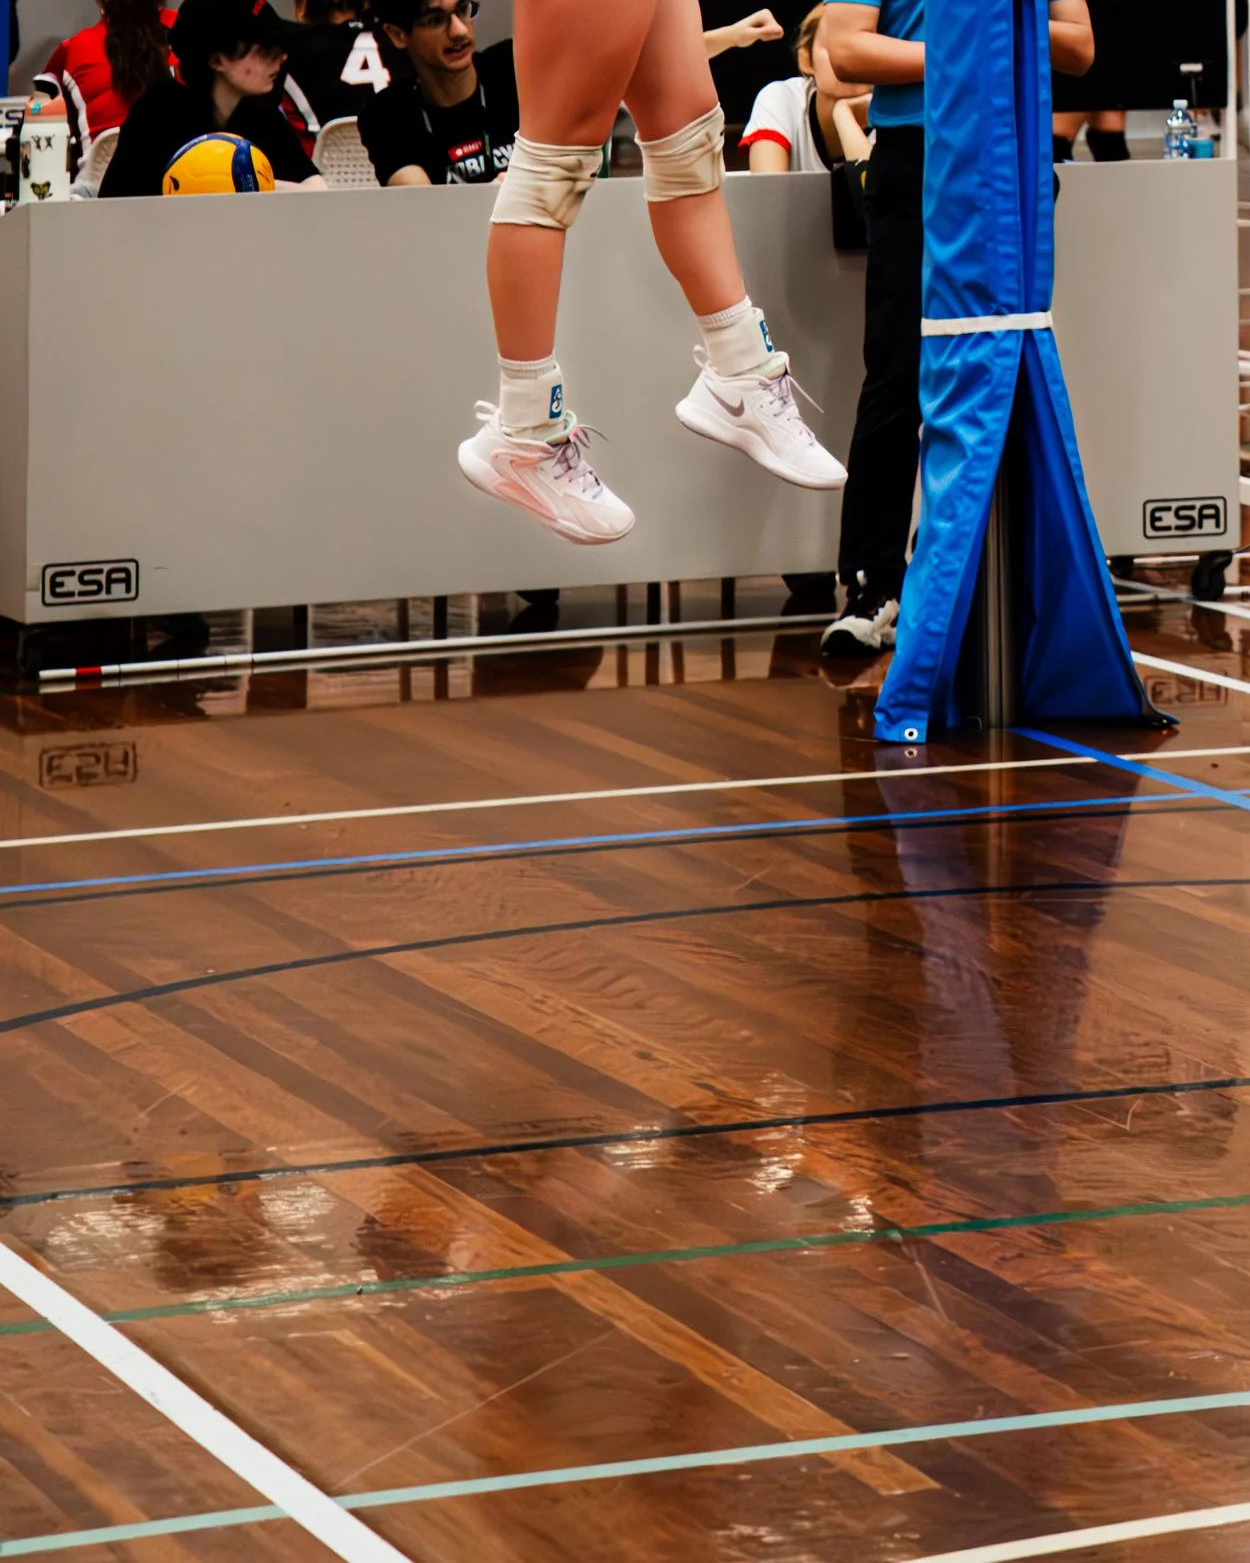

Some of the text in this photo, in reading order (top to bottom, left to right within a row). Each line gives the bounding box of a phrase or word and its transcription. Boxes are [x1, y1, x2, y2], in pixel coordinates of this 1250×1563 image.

[339, 31, 391, 95] 4
[1149, 503, 1221, 532] ESA
[49, 566, 132, 600] ESA
